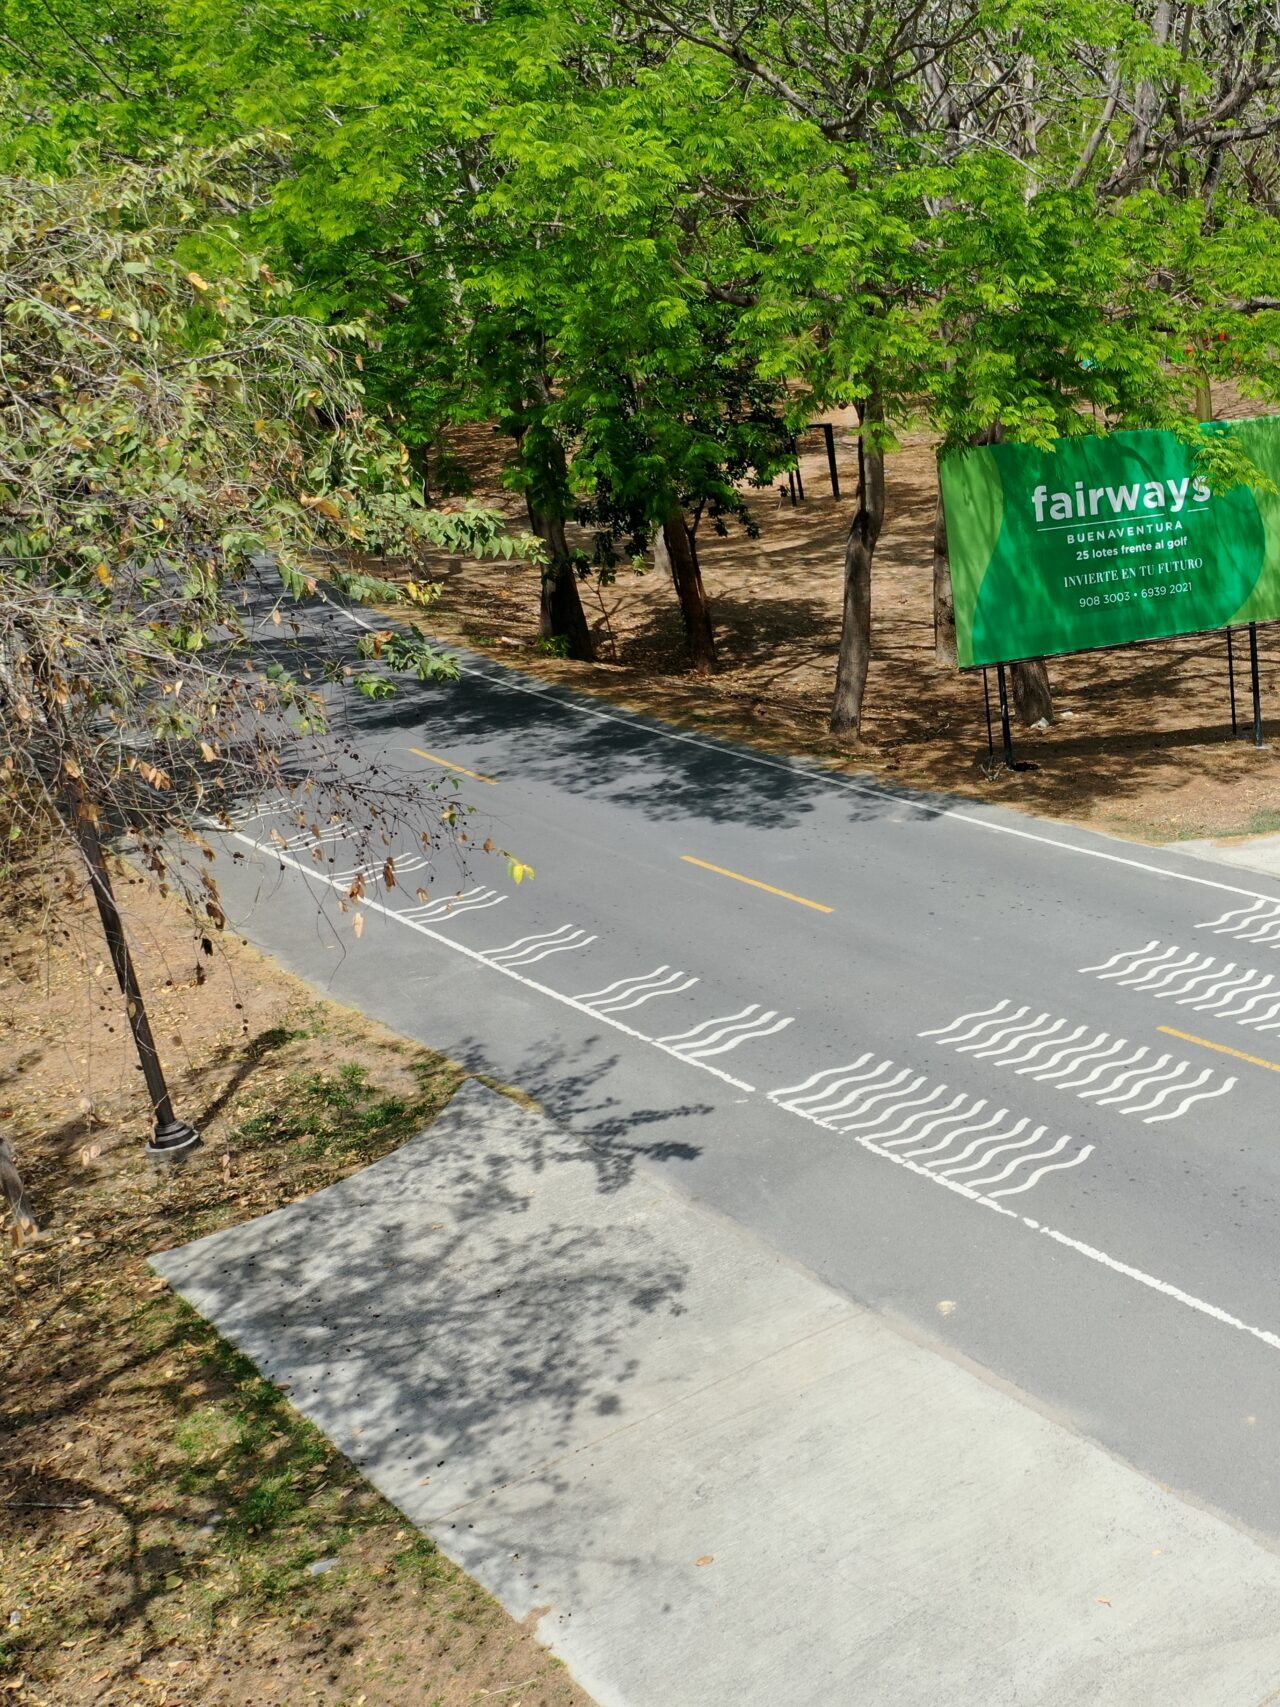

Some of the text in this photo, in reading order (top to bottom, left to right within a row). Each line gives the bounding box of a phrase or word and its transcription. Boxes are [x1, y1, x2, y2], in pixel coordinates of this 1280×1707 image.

[1032, 476, 1211, 521] fairways
[1067, 520, 1183, 544] BUENAVENTURA
[1076, 536, 1188, 561] 25 lotes frente al golf
[1064, 557, 1203, 588] INVIERTE EN TU FUTURO
[1079, 582, 1192, 608] 908 3003 6939 2021
